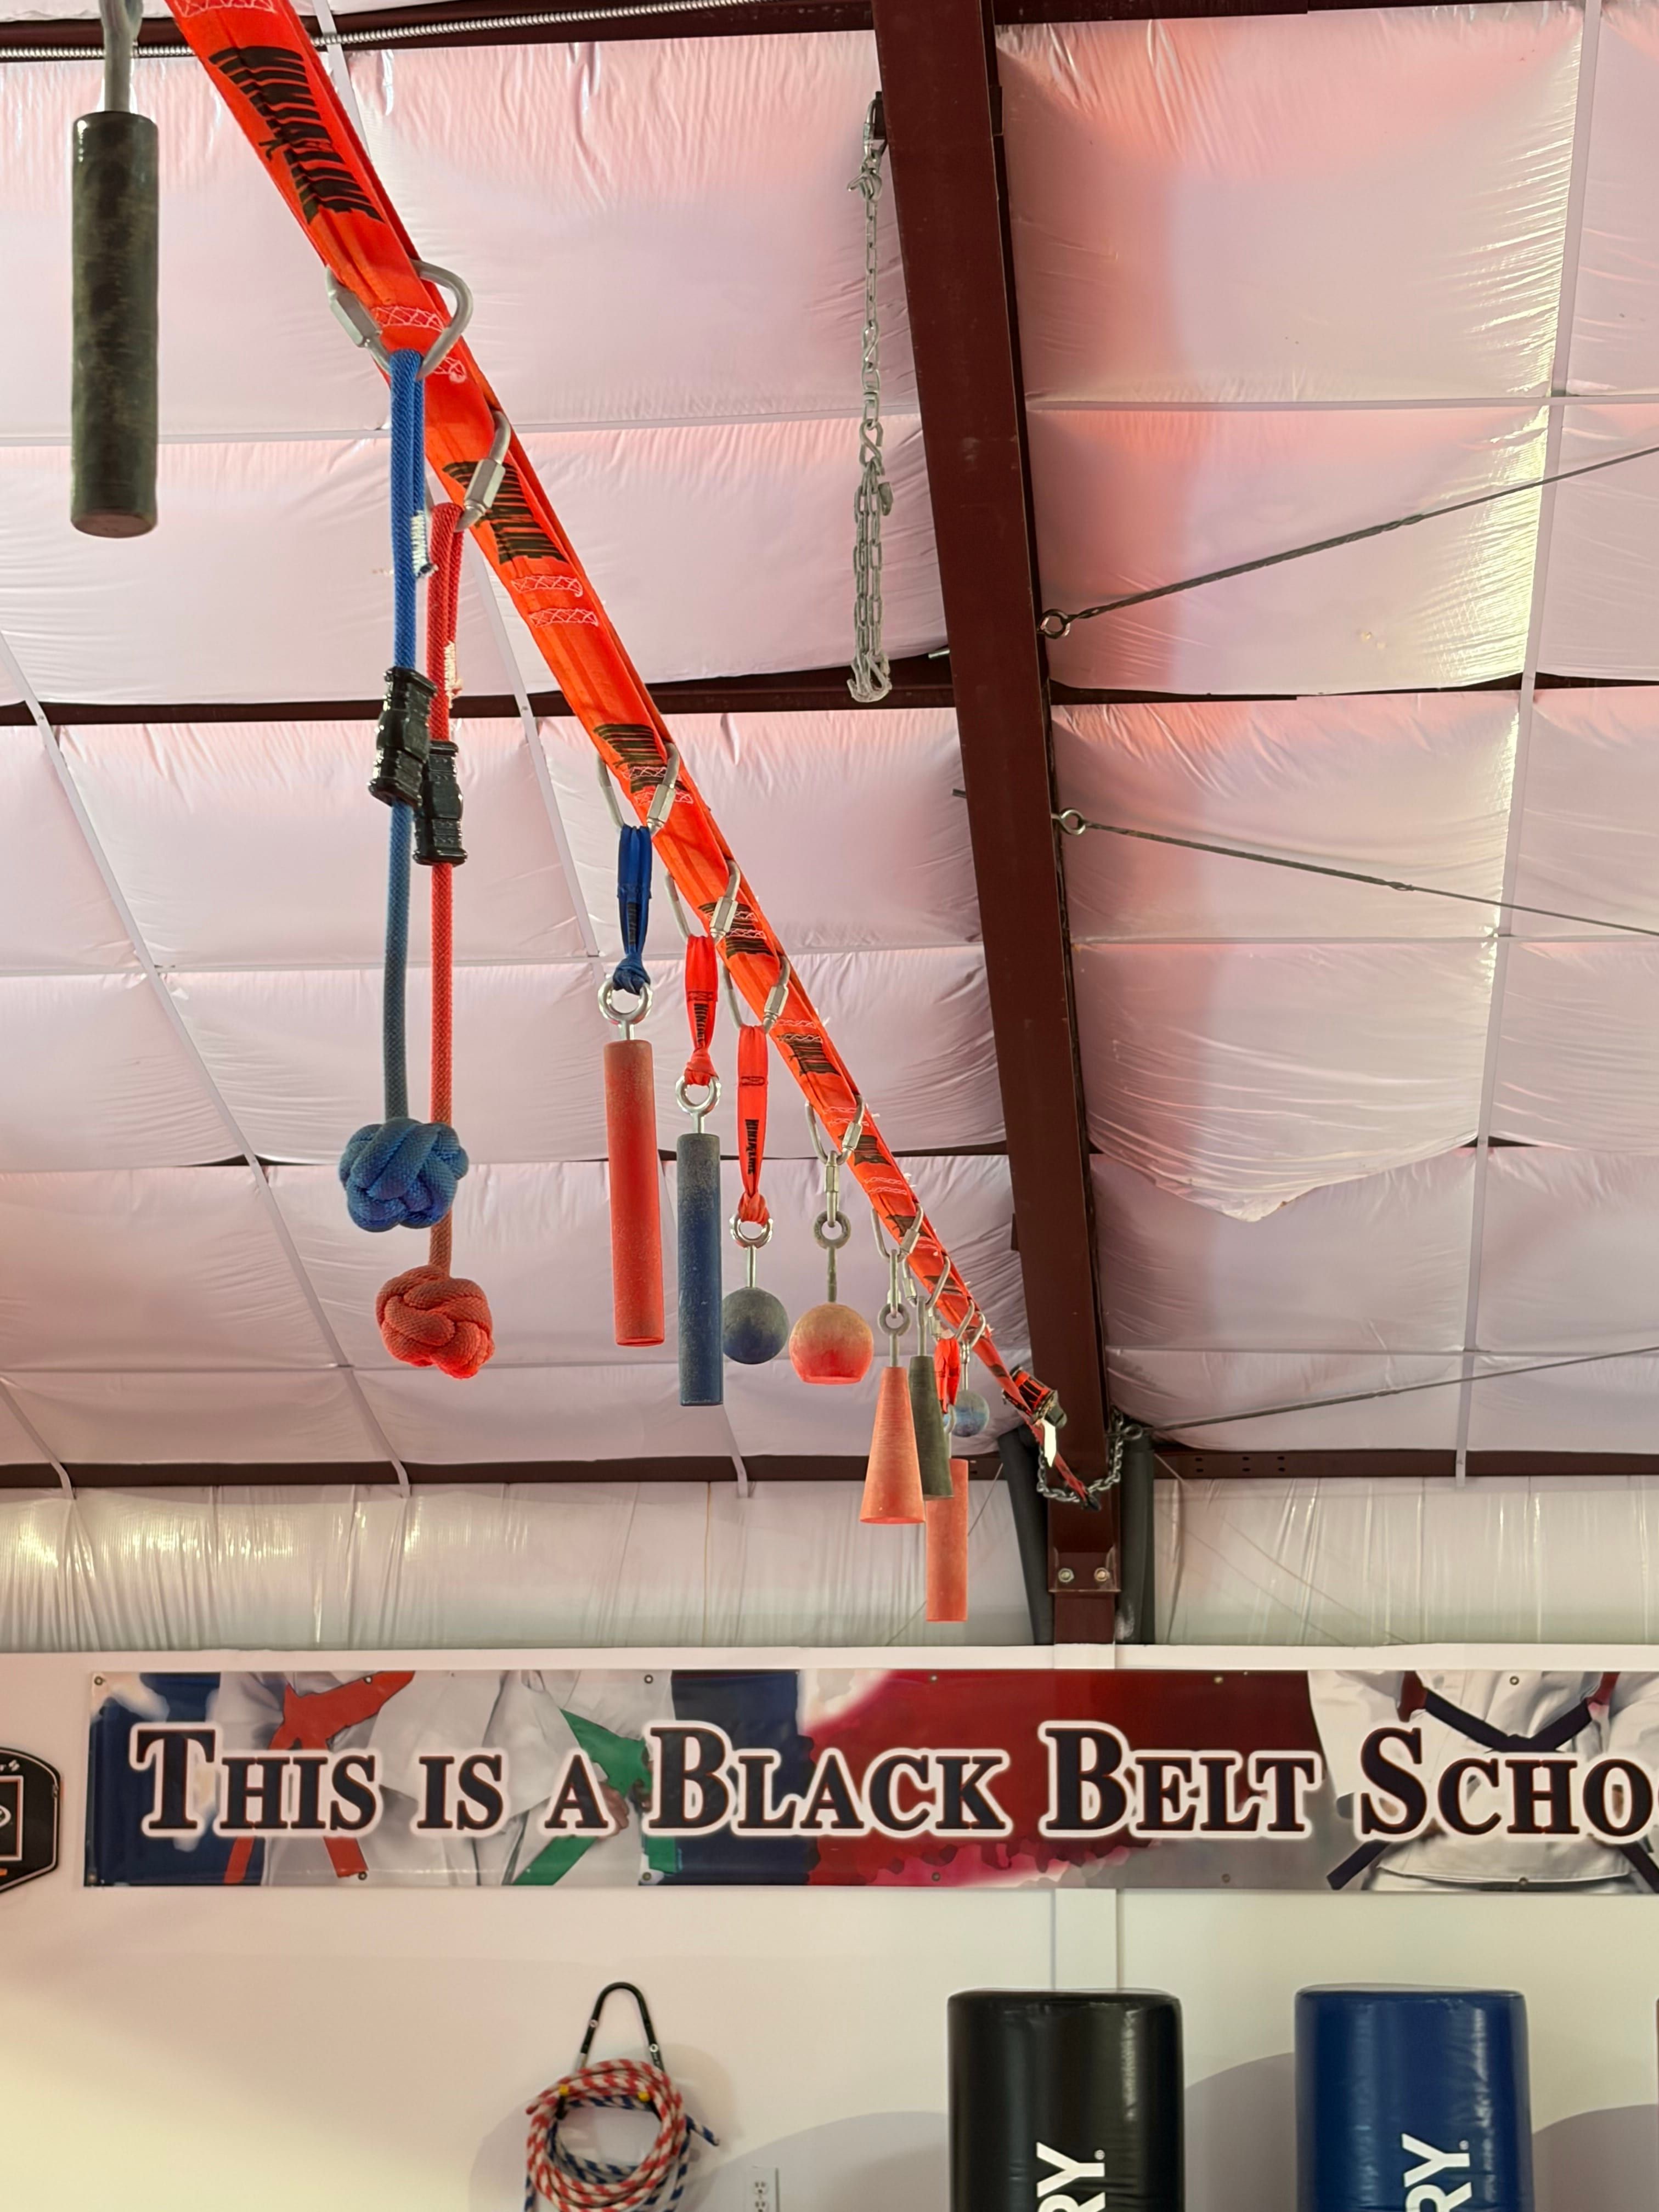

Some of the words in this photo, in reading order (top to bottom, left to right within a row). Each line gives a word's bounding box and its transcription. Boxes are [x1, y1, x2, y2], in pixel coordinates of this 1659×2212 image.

[136, 1729, 375, 1830] THIS
[417, 1754, 503, 1830] IS
[545, 1754, 607, 1830] A
[649, 1727, 1007, 1831] BLACK
[1046, 1728, 1316, 1832] BELT
